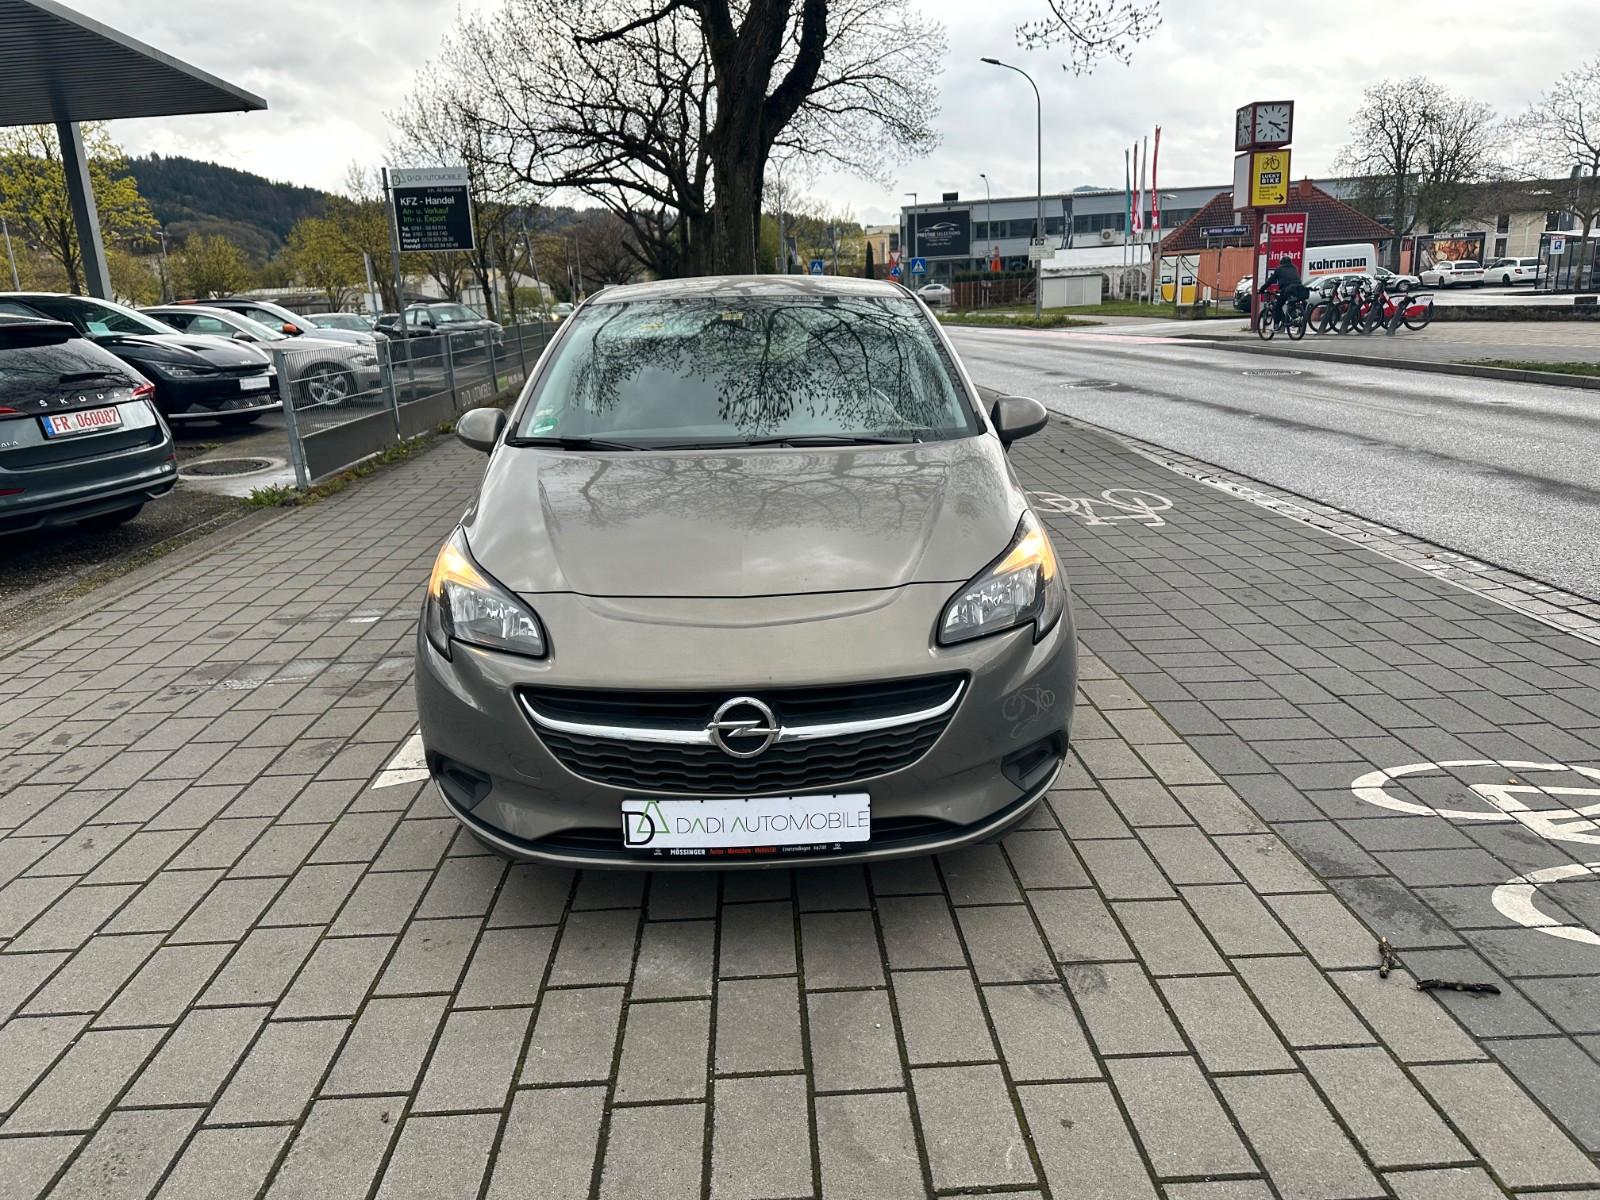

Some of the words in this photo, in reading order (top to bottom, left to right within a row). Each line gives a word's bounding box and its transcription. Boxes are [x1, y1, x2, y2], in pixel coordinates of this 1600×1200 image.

[400, 197, 418, 206] KFZ
[425, 196, 454, 205] Handel
[1270, 222, 1303, 234] REWE
[1268, 250, 1301, 260] infhrt
[51, 416, 71, 432] FR
[75, 408, 117, 428] 060087
[676, 817, 724, 833] DADI
[731, 810, 869, 832] AUTOMOBILE
